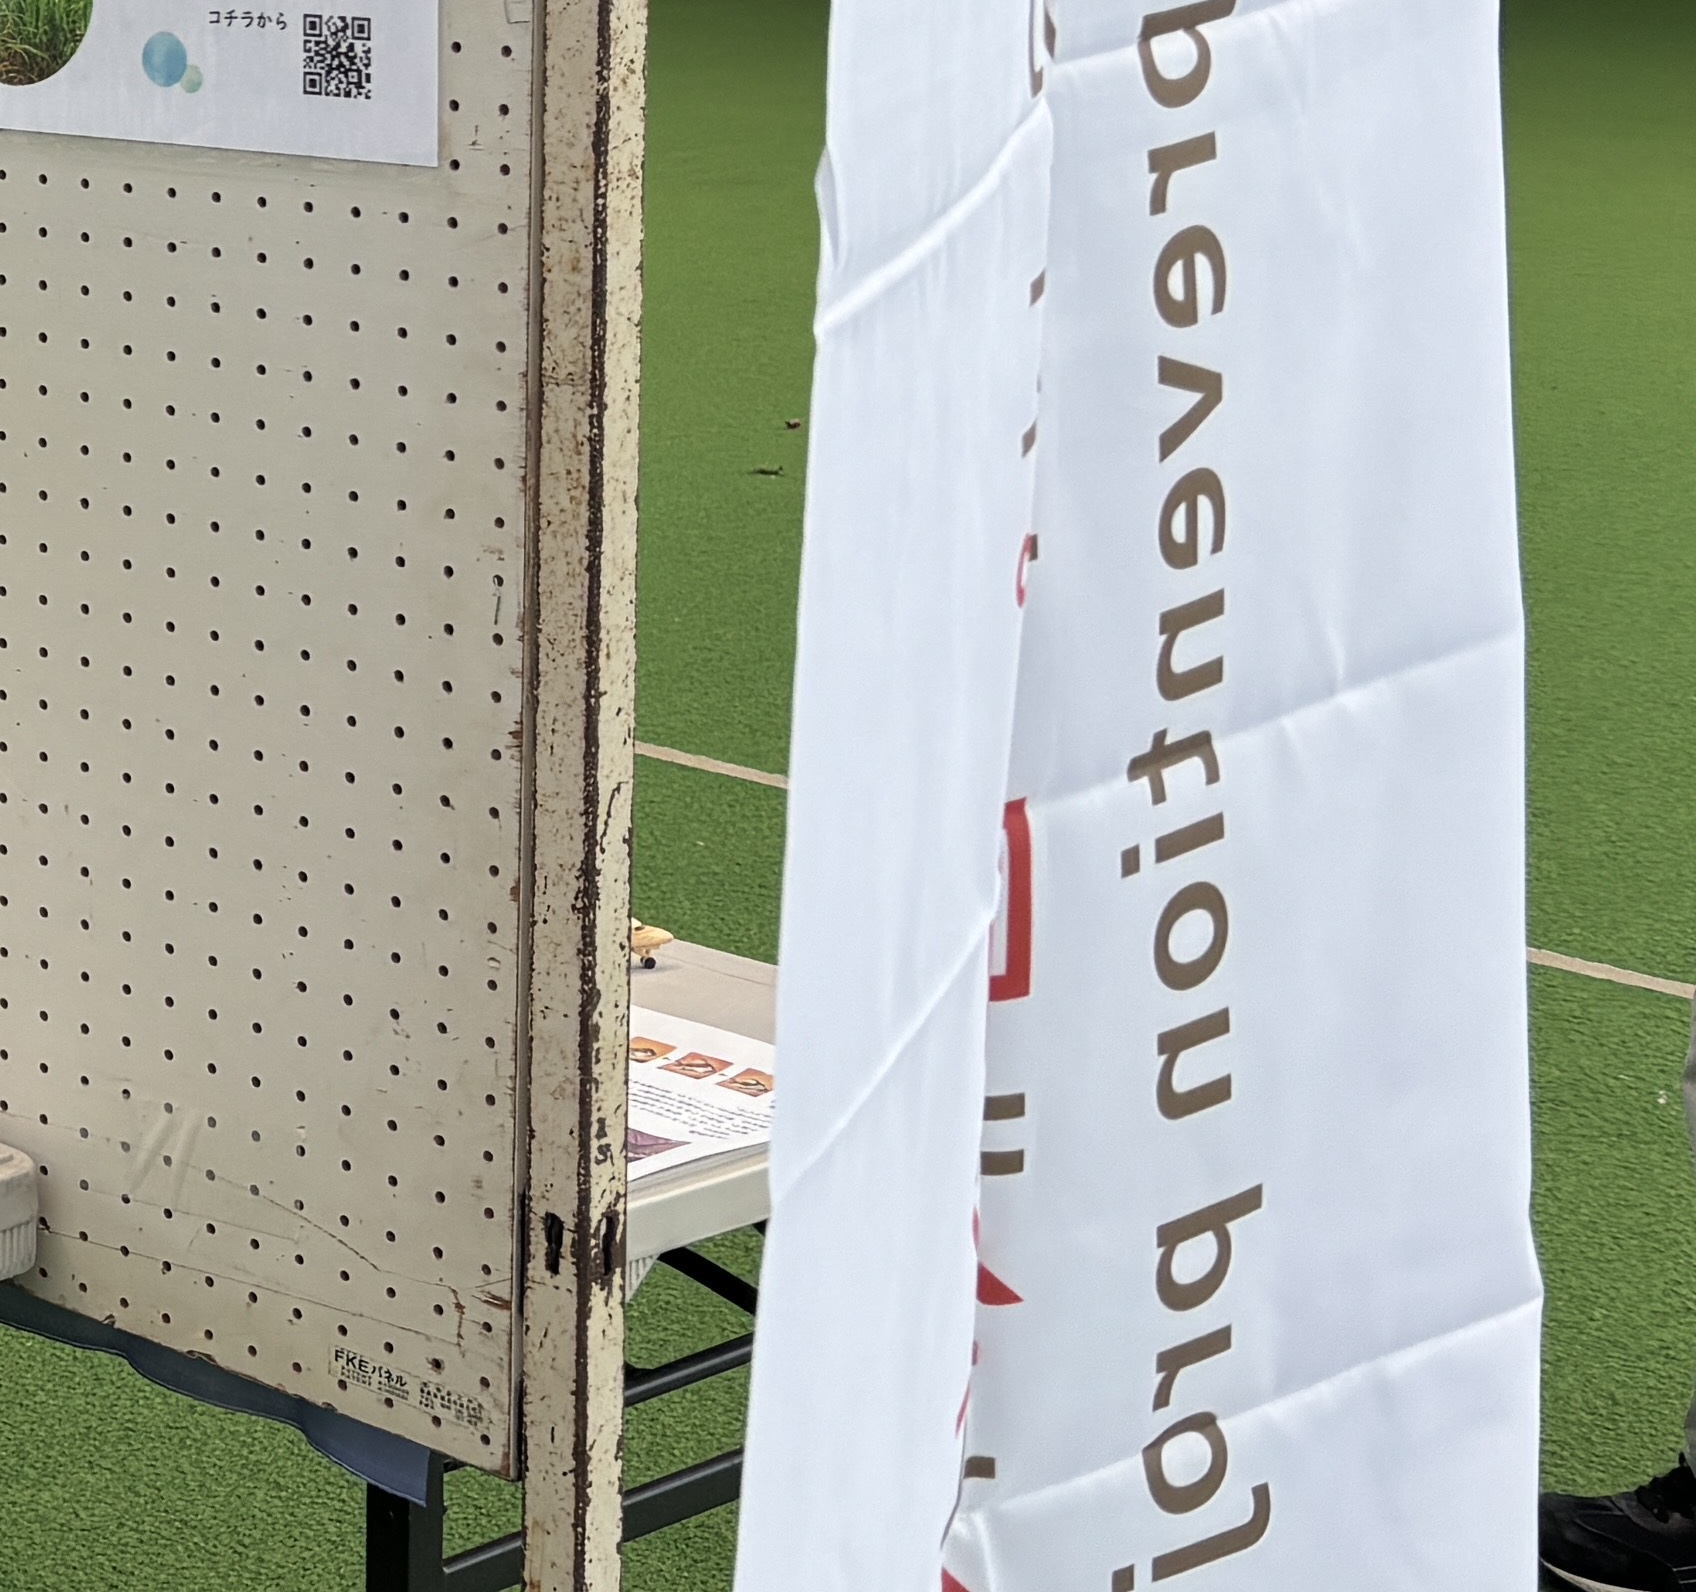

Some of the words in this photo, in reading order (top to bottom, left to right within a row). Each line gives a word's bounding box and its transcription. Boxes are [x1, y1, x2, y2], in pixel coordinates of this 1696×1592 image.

[208, 8, 287, 31] コチラから
